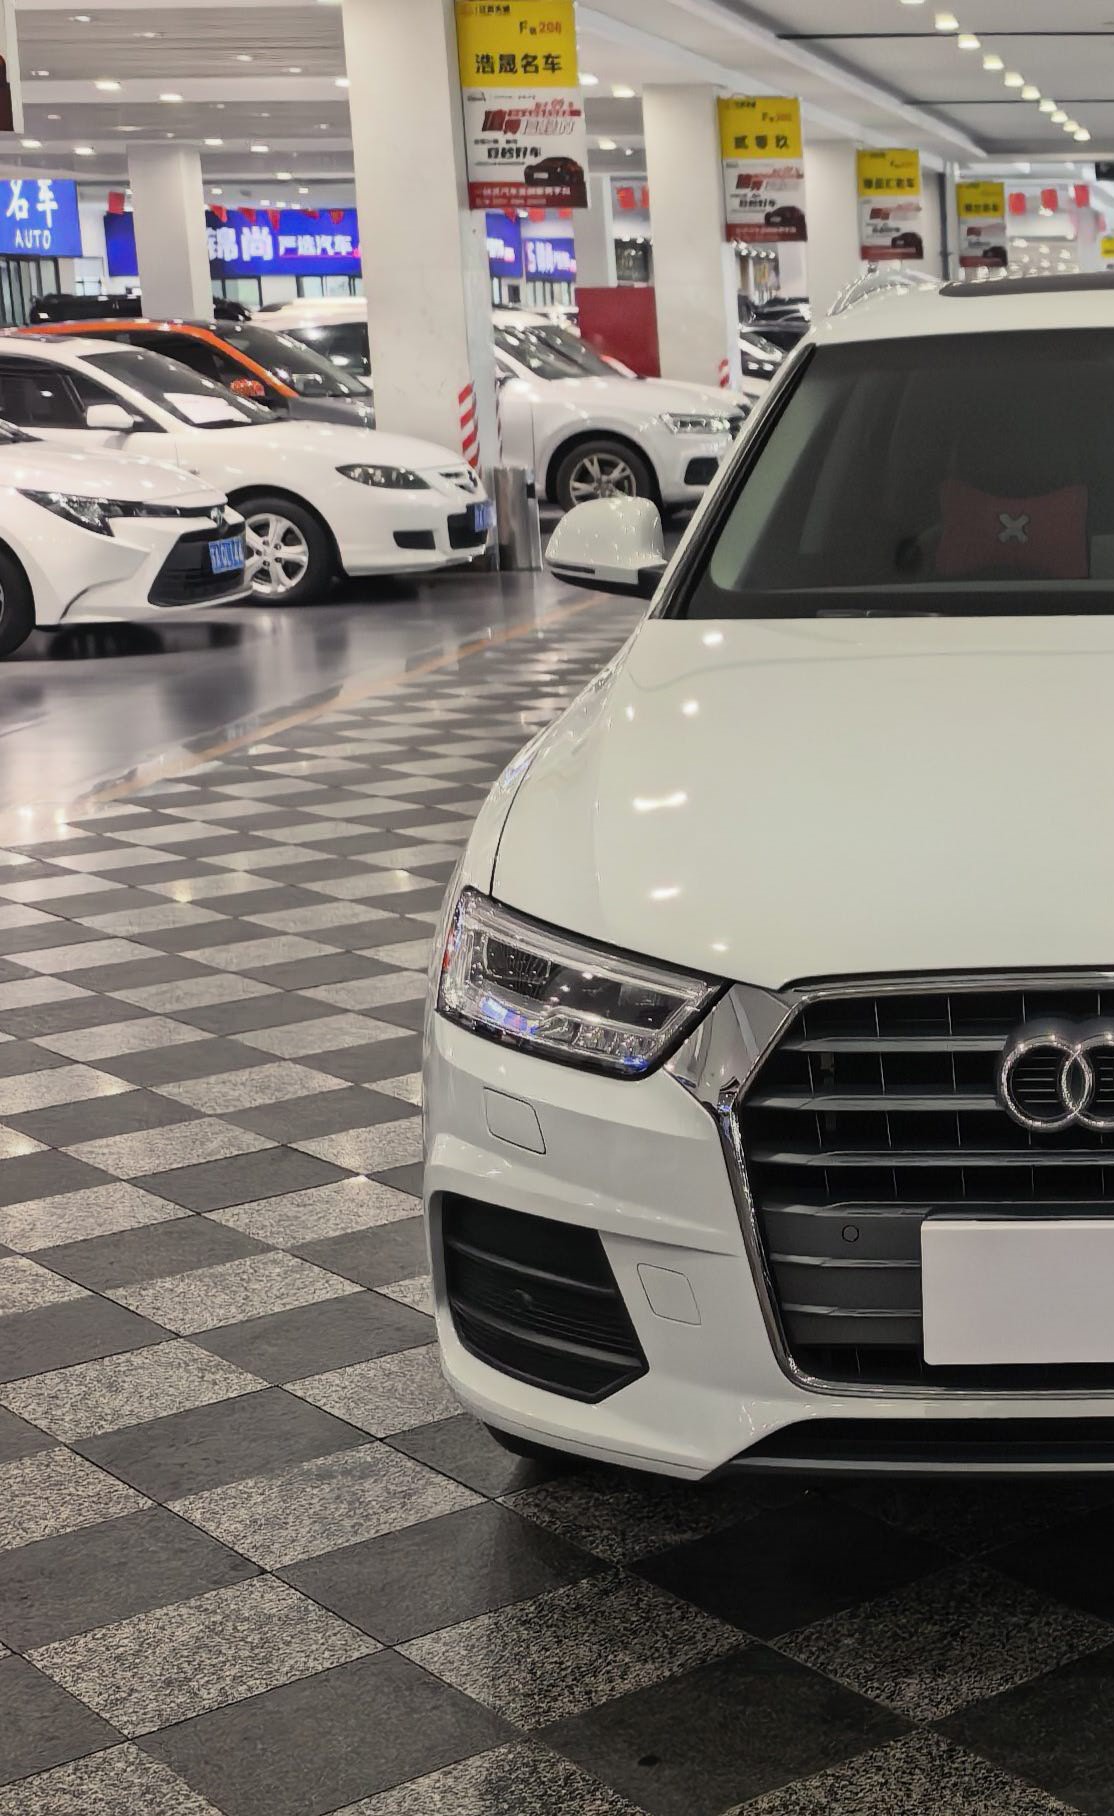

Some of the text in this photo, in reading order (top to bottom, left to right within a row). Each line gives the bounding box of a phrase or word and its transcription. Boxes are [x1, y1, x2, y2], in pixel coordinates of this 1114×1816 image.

[475, 53, 562, 74] 浩晟名车
[15, 229, 51, 250] AUTO
